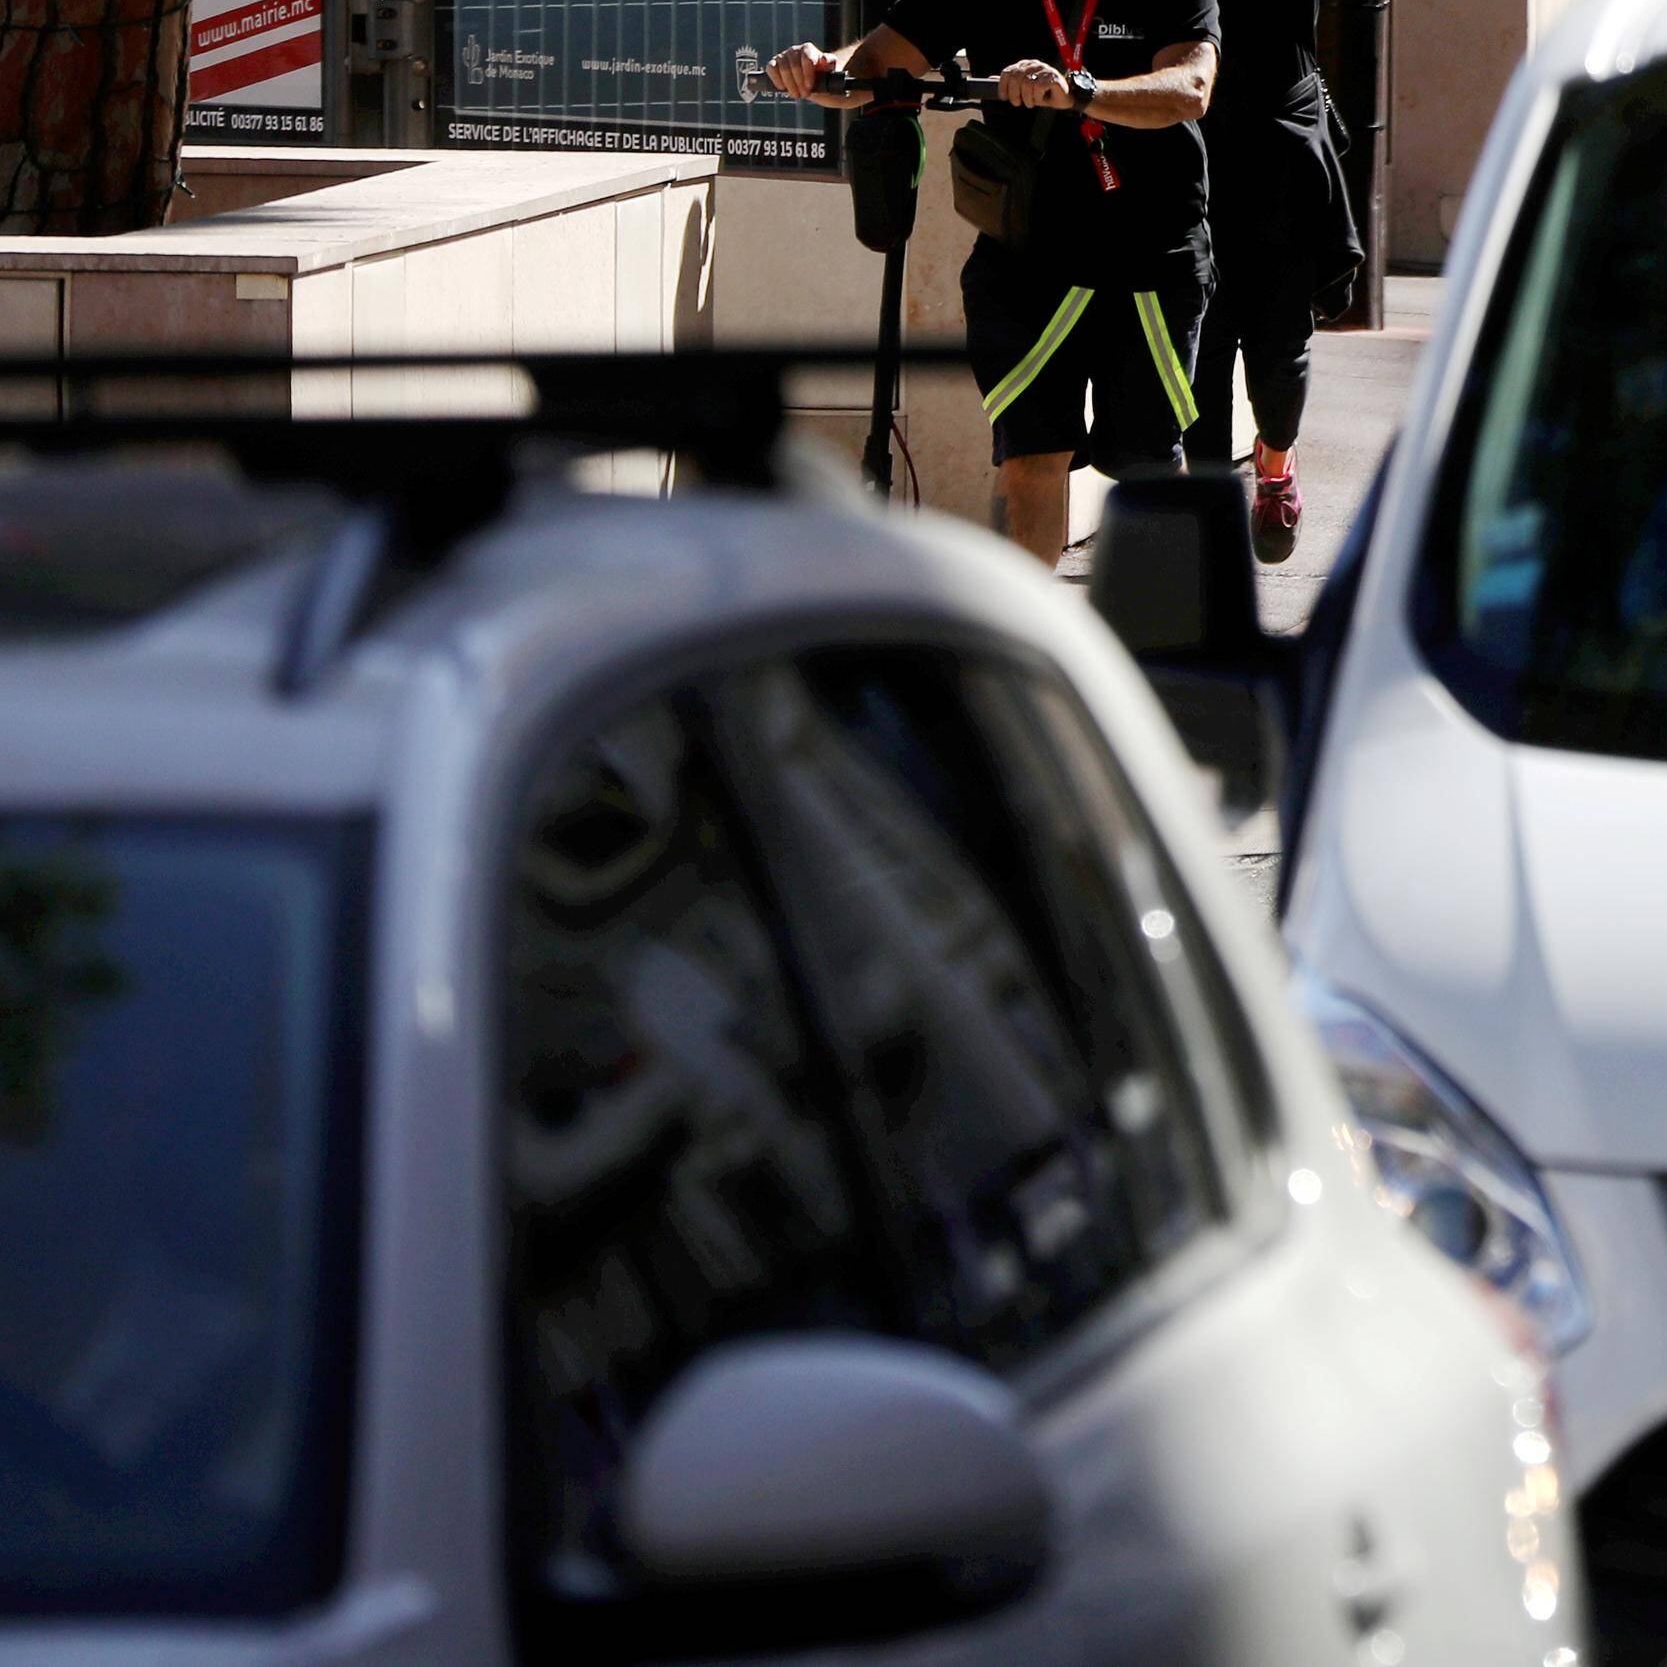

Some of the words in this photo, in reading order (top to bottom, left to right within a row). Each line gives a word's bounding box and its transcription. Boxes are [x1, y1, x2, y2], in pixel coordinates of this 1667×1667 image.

[485, 49, 513, 64] Jardin
[515, 50, 556, 70] Exotique
[581, 57, 707, 80] www.jardin-exotique.mc
[485, 65, 496, 78] de
[498, 66, 535, 80] Monaco
[231, 114, 263, 131] 00377
[265, 115, 279, 131] 93
[280, 117, 292, 133] 15
[294, 117, 307, 133] 61
[309, 117, 324, 133] 86
[448, 123, 501, 142] SERVICE
[503, 126, 521, 143] DE
[523, 127, 602, 148] L'AFFICHAGE
[605, 132, 620, 149] ET
[623, 133, 640, 150] DE
[643, 135, 658, 151] LA
[661, 134, 723, 155] PUBLICITÉ
[727, 139, 761, 156] 00377
[763, 140, 777, 157] 93
[780, 141, 793, 158] 15
[795, 142, 809, 159] 61
[811, 143, 826, 159] 86
